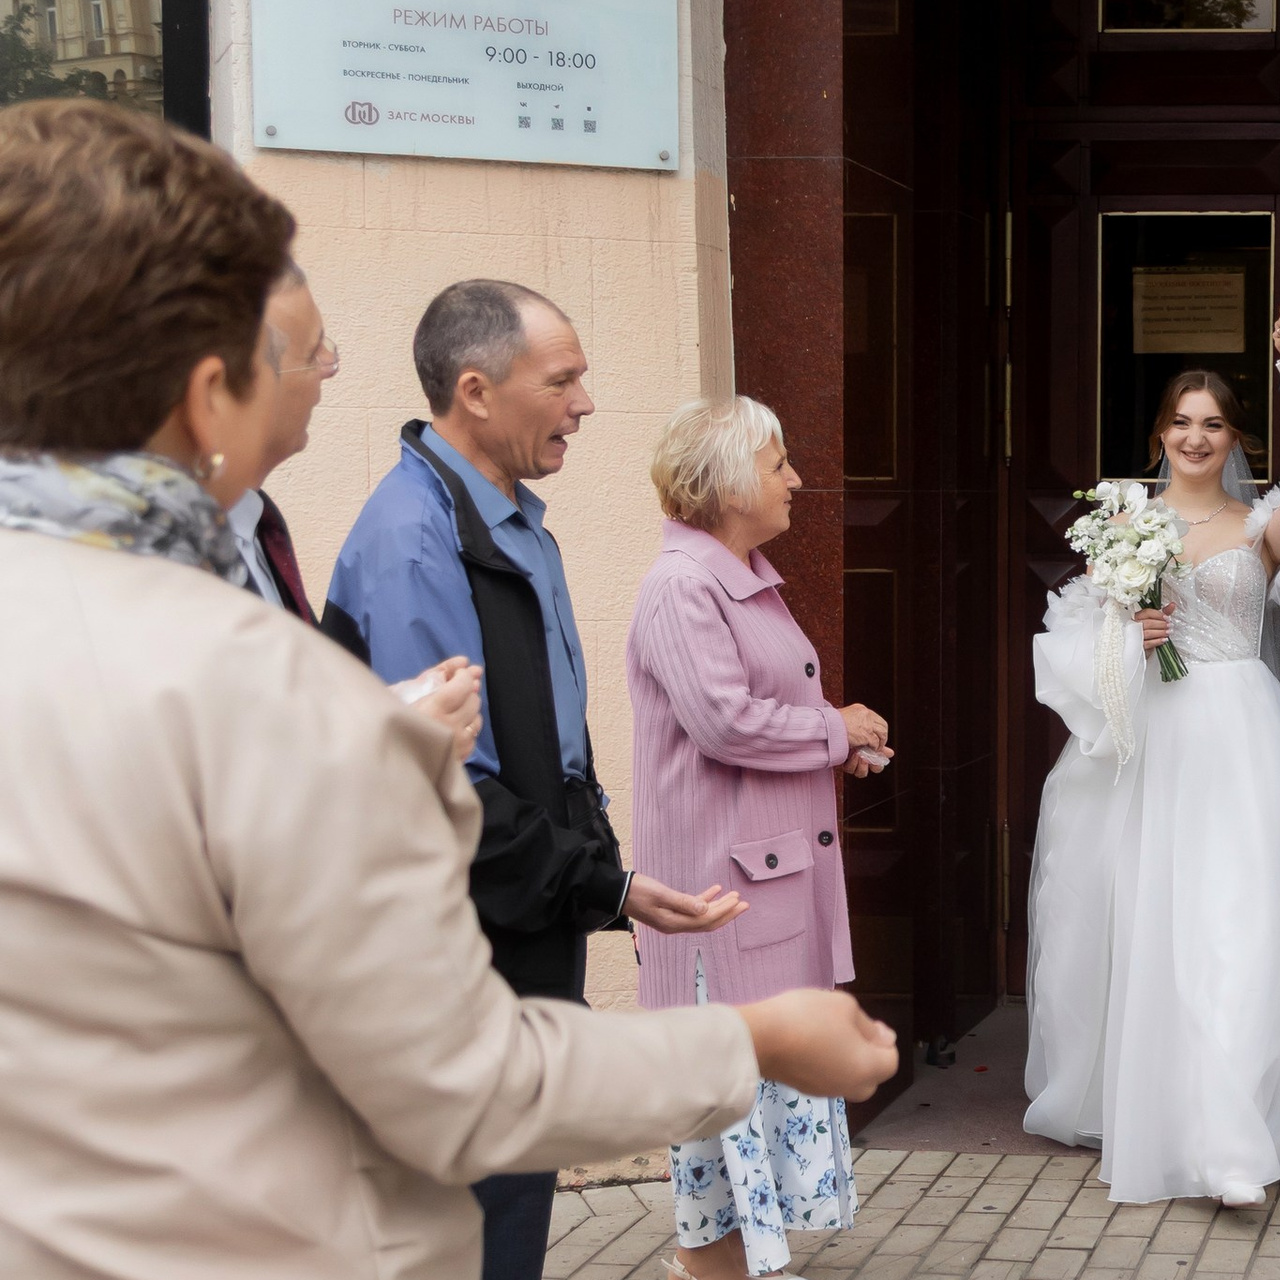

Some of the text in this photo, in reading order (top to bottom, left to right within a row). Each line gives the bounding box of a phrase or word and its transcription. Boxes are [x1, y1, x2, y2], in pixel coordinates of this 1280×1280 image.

[393, 8, 548, 36] РЕЖИМ РАБОТЫ
[342, 40, 381, 50] ВТОРНИК
[388, 43, 426, 53] СУББОТА
[485, 46, 527, 64] 9:00
[548, 50, 596, 69] 18:00
[343, 69, 401, 80] ВОСКРЕСЕНЬЕ
[408, 73, 470, 85] ПОНЕДЕЛЬНИК
[516, 81, 564, 92] ВЫХОДНОЙ
[388, 110, 475, 125] ЗАГС МОСКВЫ
